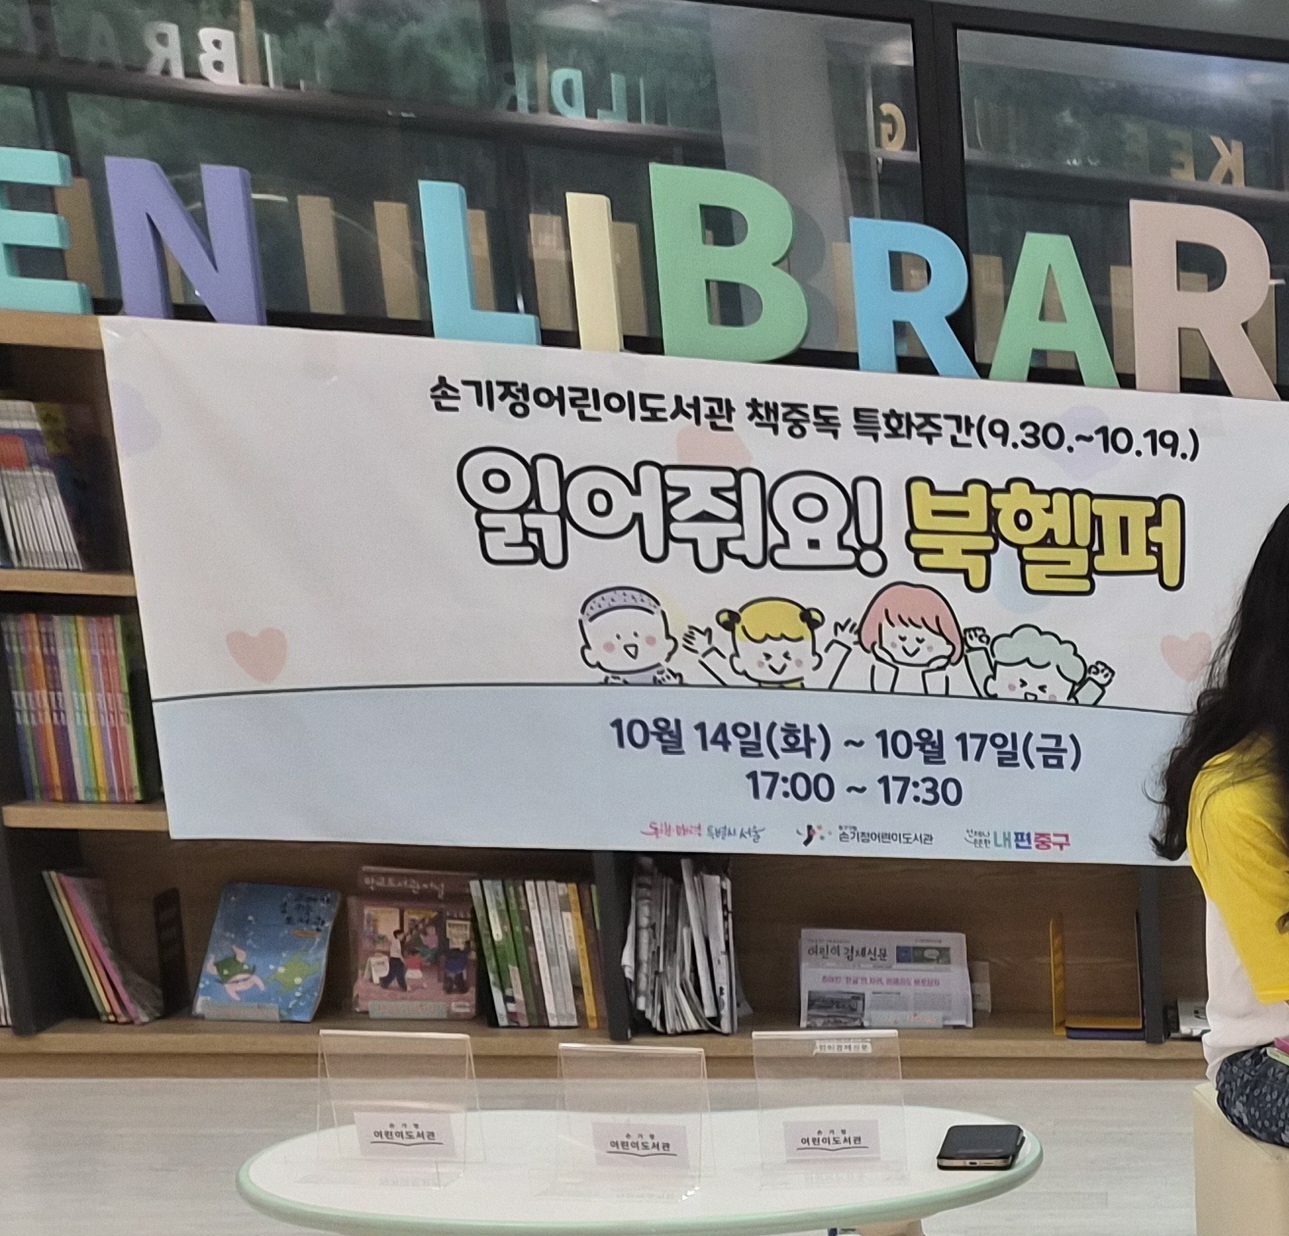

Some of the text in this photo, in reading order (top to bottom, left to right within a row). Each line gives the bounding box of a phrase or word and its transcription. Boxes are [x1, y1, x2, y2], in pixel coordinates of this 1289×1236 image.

[429, 375, 1200, 462] 손기정어린이도서관 책중독 특화주간(9.30.~10.19.)
[456, 445, 1185, 597] 읽어줘요! 북헬퍼
[609, 718, 686, 756] 10월
[694, 721, 832, 763] 14일(화)
[875, 728, 946, 766] 10월
[954, 731, 1082, 773] 17일(금)
[746, 769, 835, 804] 17:00
[876, 775, 963, 808] 17:30
[807, 944, 888, 962] 어린이 경제신문
[373, 1130, 436, 1140] 어린이도서관
[610, 1140, 671, 1152] 어린이도서관
[800, 1135, 862, 1146] 어린이도서관
